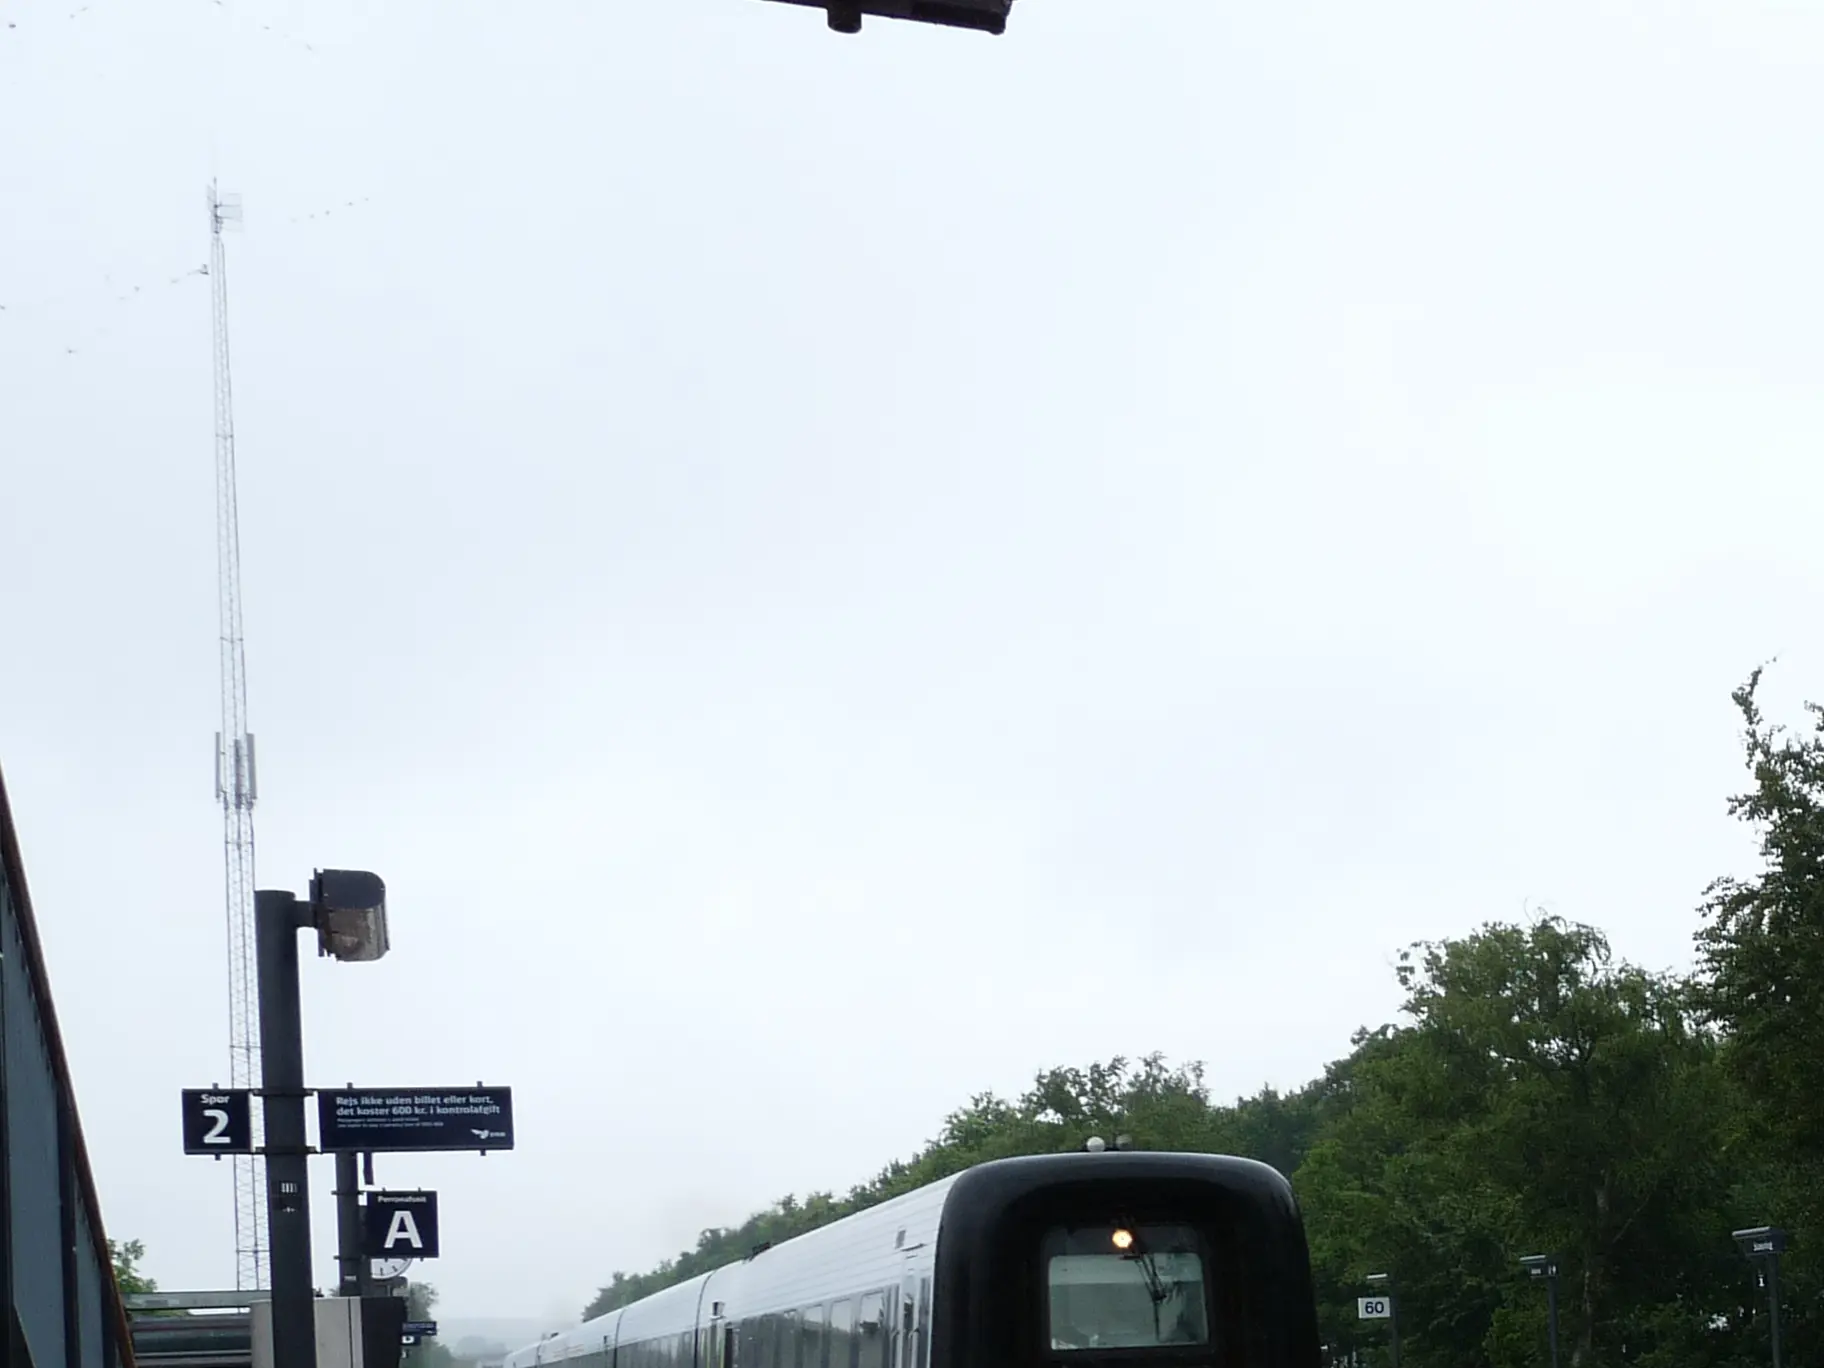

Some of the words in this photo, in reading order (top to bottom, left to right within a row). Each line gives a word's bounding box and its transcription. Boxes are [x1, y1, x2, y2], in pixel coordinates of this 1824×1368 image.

[201, 1094, 230, 1105] Spor
[336, 1096, 358, 1106] Rejs
[361, 1096, 383, 1105] ikke
[386, 1096, 412, 1105] uden
[414, 1095, 441, 1104] billet
[443, 1095, 467, 1104] eller
[336, 1107, 354, 1116] det
[357, 1106, 389, 1115] koster
[392, 1106, 412, 1115] 600
[414, 1105, 427, 1114] kr.
[436, 1104, 500, 1115] kontrolafgift
[203, 1109, 231, 1143] 2
[384, 1211, 423, 1248] A
[1365, 1301, 1384, 1314] 60
